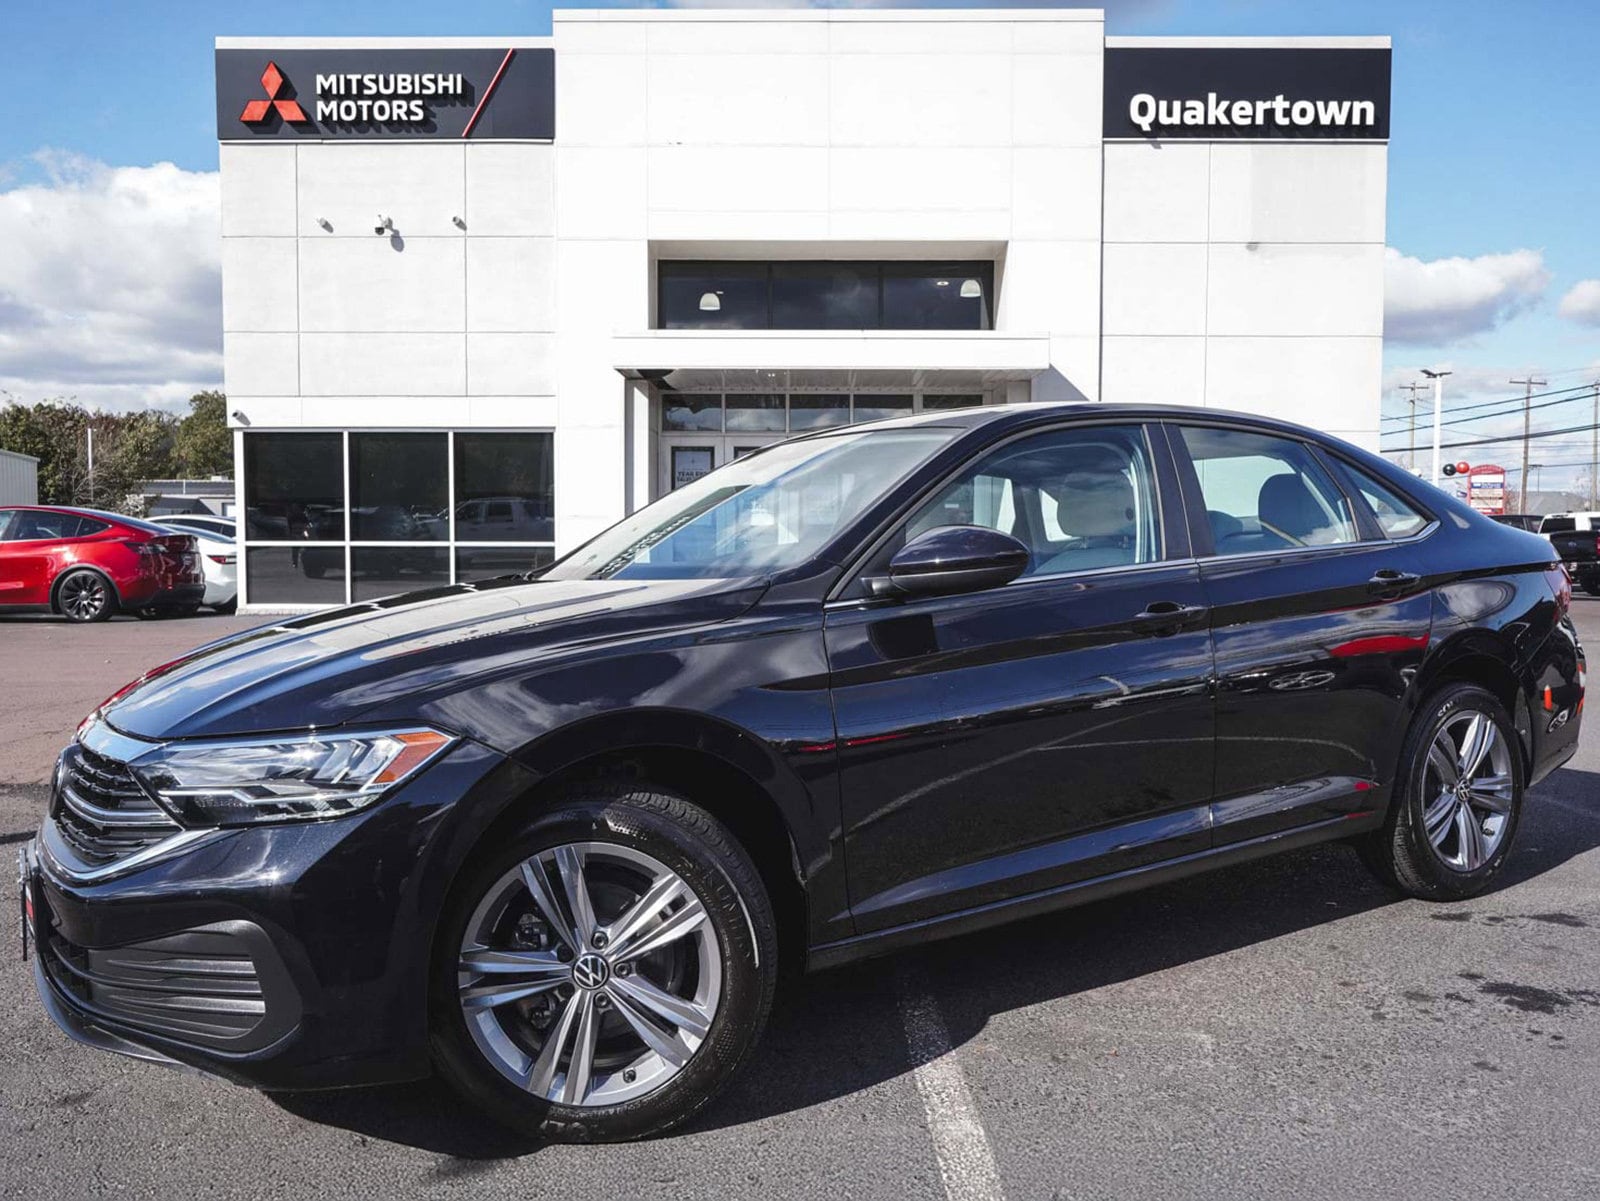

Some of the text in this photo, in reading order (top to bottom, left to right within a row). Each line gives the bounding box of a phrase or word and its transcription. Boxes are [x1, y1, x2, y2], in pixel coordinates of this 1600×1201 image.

[316, 74, 461, 94] MITSUBISHI
[317, 100, 423, 120] MOTORS
[1130, 93, 1374, 130] Quakertown
